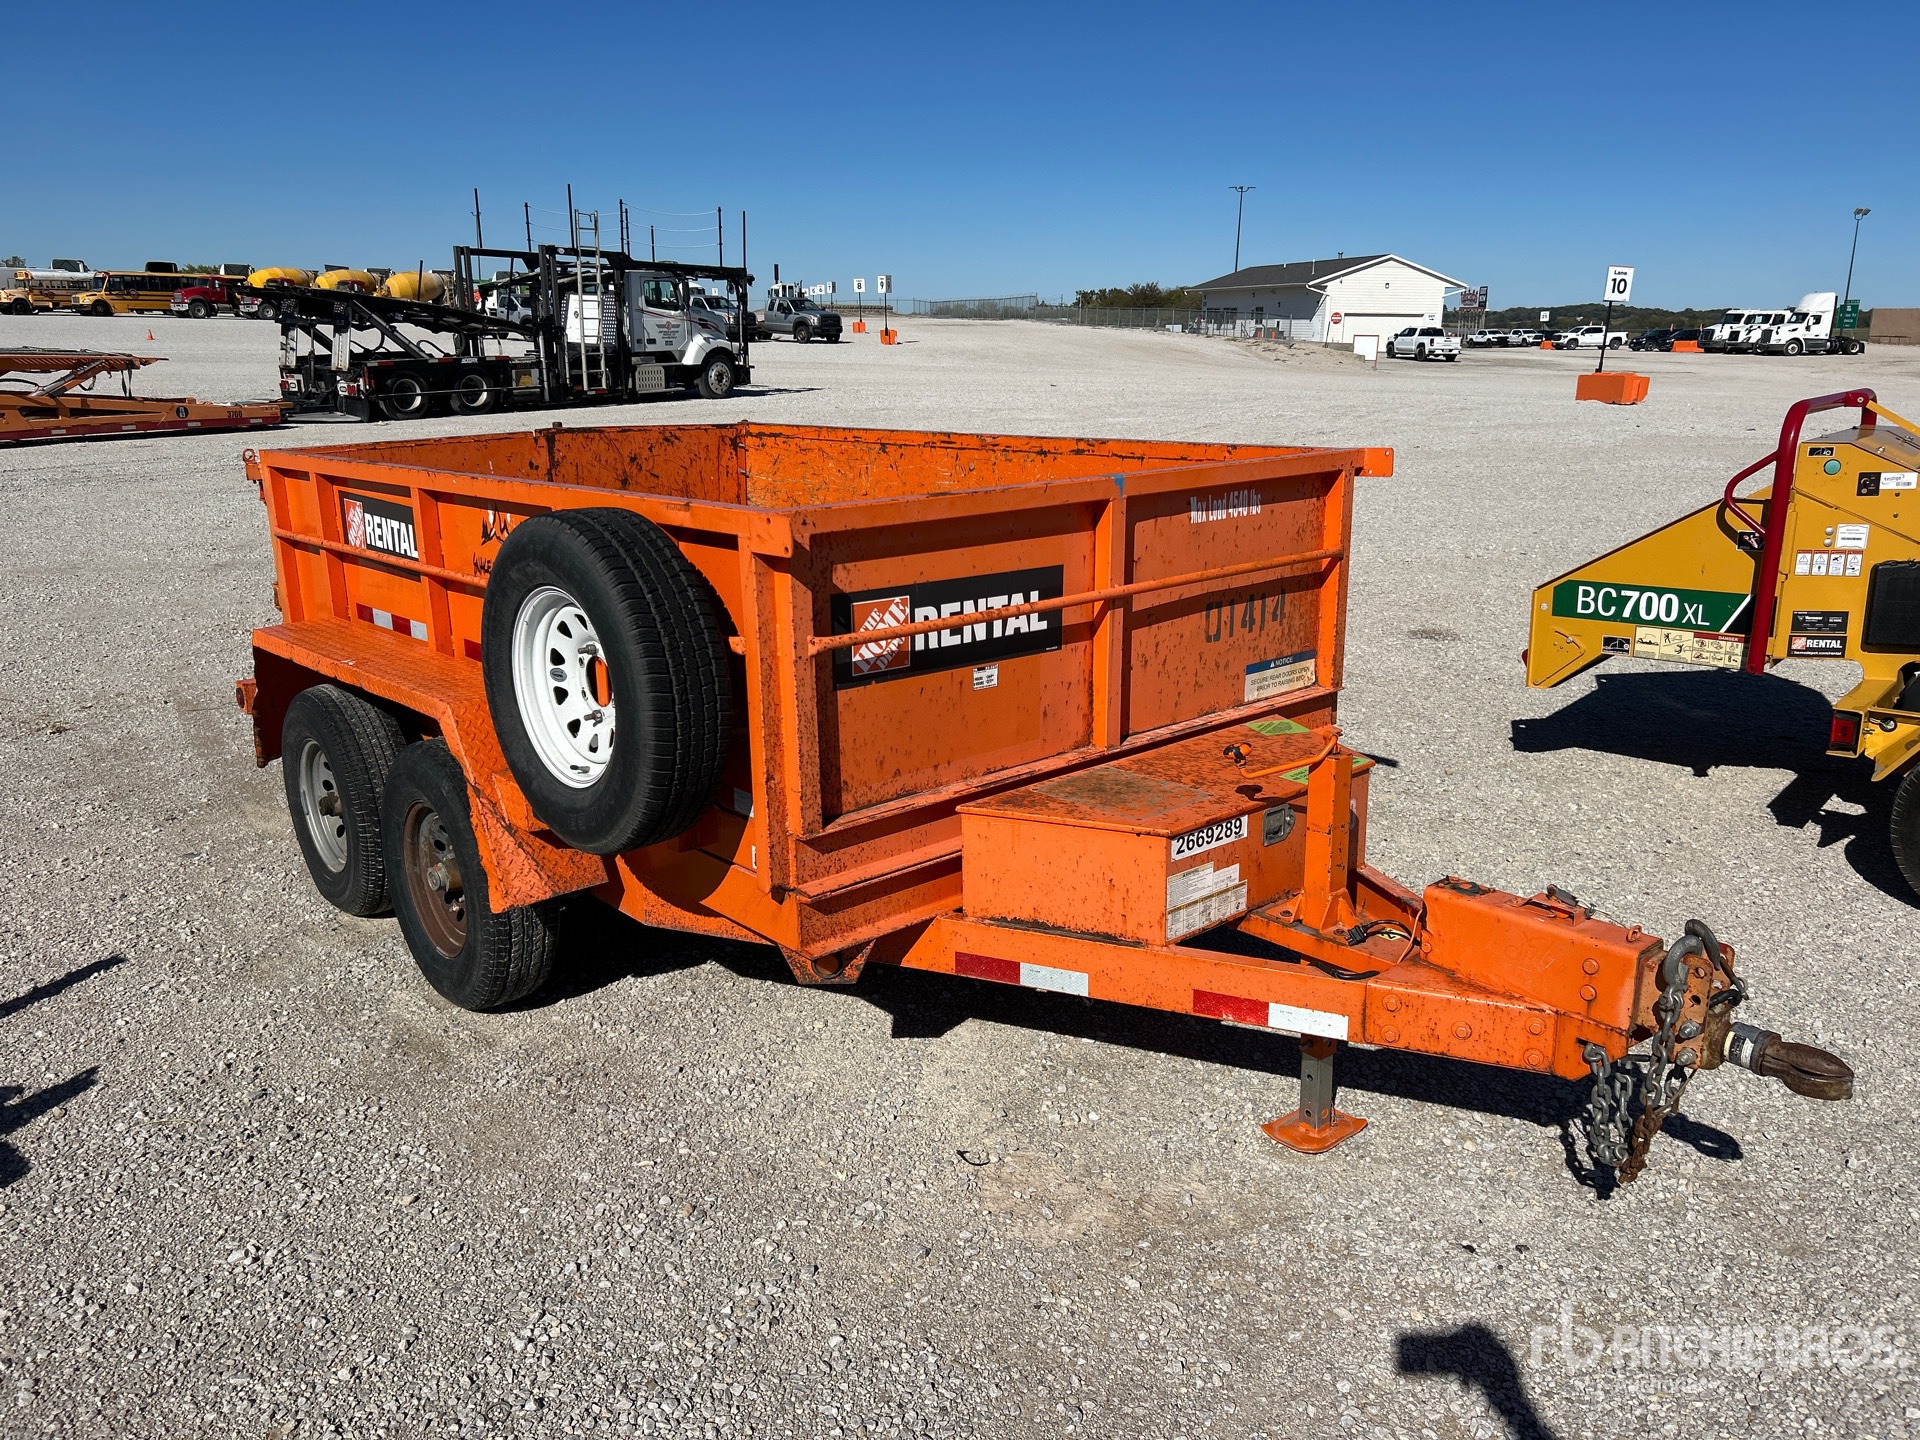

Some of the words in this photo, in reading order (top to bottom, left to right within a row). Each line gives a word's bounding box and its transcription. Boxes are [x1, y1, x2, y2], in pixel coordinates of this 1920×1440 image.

[856, 282, 862, 290] 8
[1611, 278, 1628, 294] 10
[226, 410, 242, 418] 3700
[1190, 496, 1206, 524] Max
[1209, 493, 1226, 522] Load
[1228, 490, 1248, 518] 4540
[1250, 488, 1262, 516] lbs
[364, 512, 418, 558] RENTAL
[1576, 585, 1679, 622] BC700
[1682, 602, 1710, 626] XL
[914, 590, 1048, 650] RENTAL
[1204, 586, 1286, 643] 01414
[1806, 640, 1842, 648] RENTAL
[1275, 656, 1293, 666] NOTICE
[1250, 676, 1269, 686] SECURE
[1282, 670, 1298, 678] DOORS
[1256, 684, 1270, 692] PRIOR
[1176, 817, 1242, 856] 2669289
